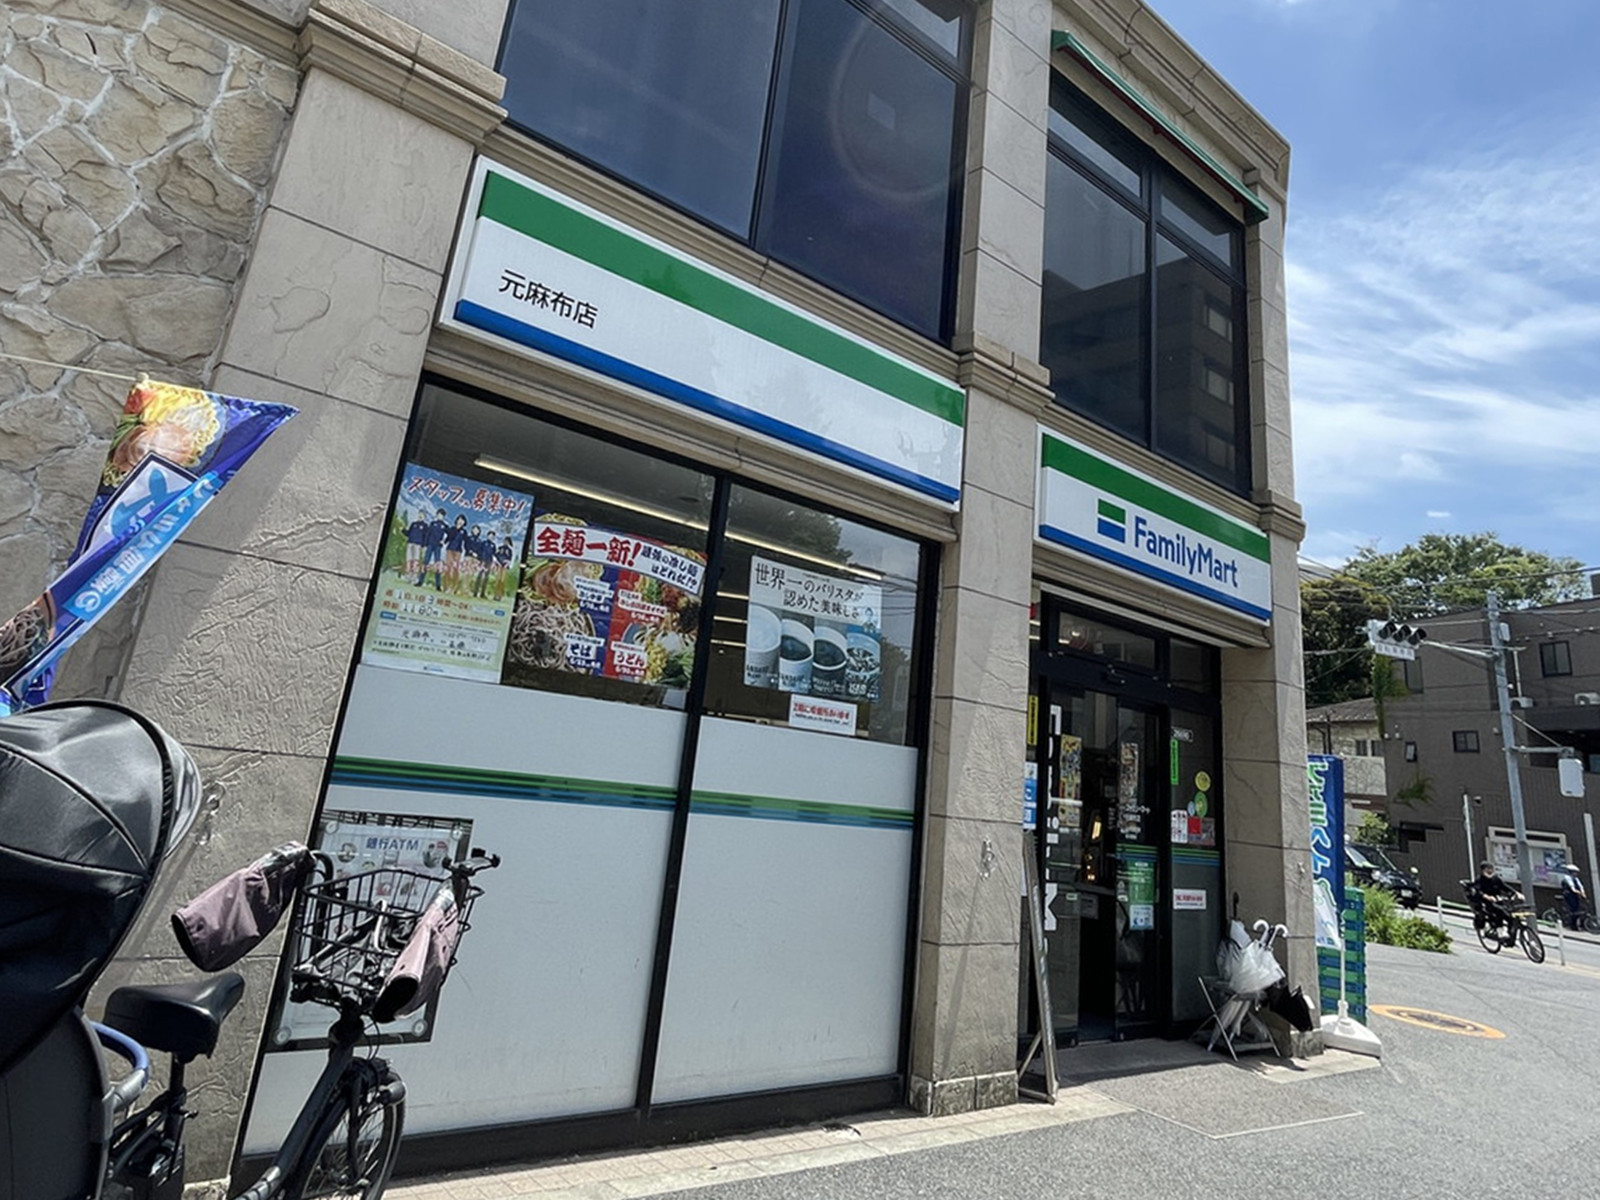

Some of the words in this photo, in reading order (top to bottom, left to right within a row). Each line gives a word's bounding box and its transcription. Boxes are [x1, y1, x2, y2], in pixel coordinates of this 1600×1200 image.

[498, 269, 598, 329] 元麻布店
[1134, 515, 1238, 588] FamilyMart
[755, 562, 865, 602] 世界一のバリスタが
[783, 589, 861, 619] 認めた美味しさ
[617, 651, 645, 667] うどん
[366, 837, 419, 850] 銀行ATM
